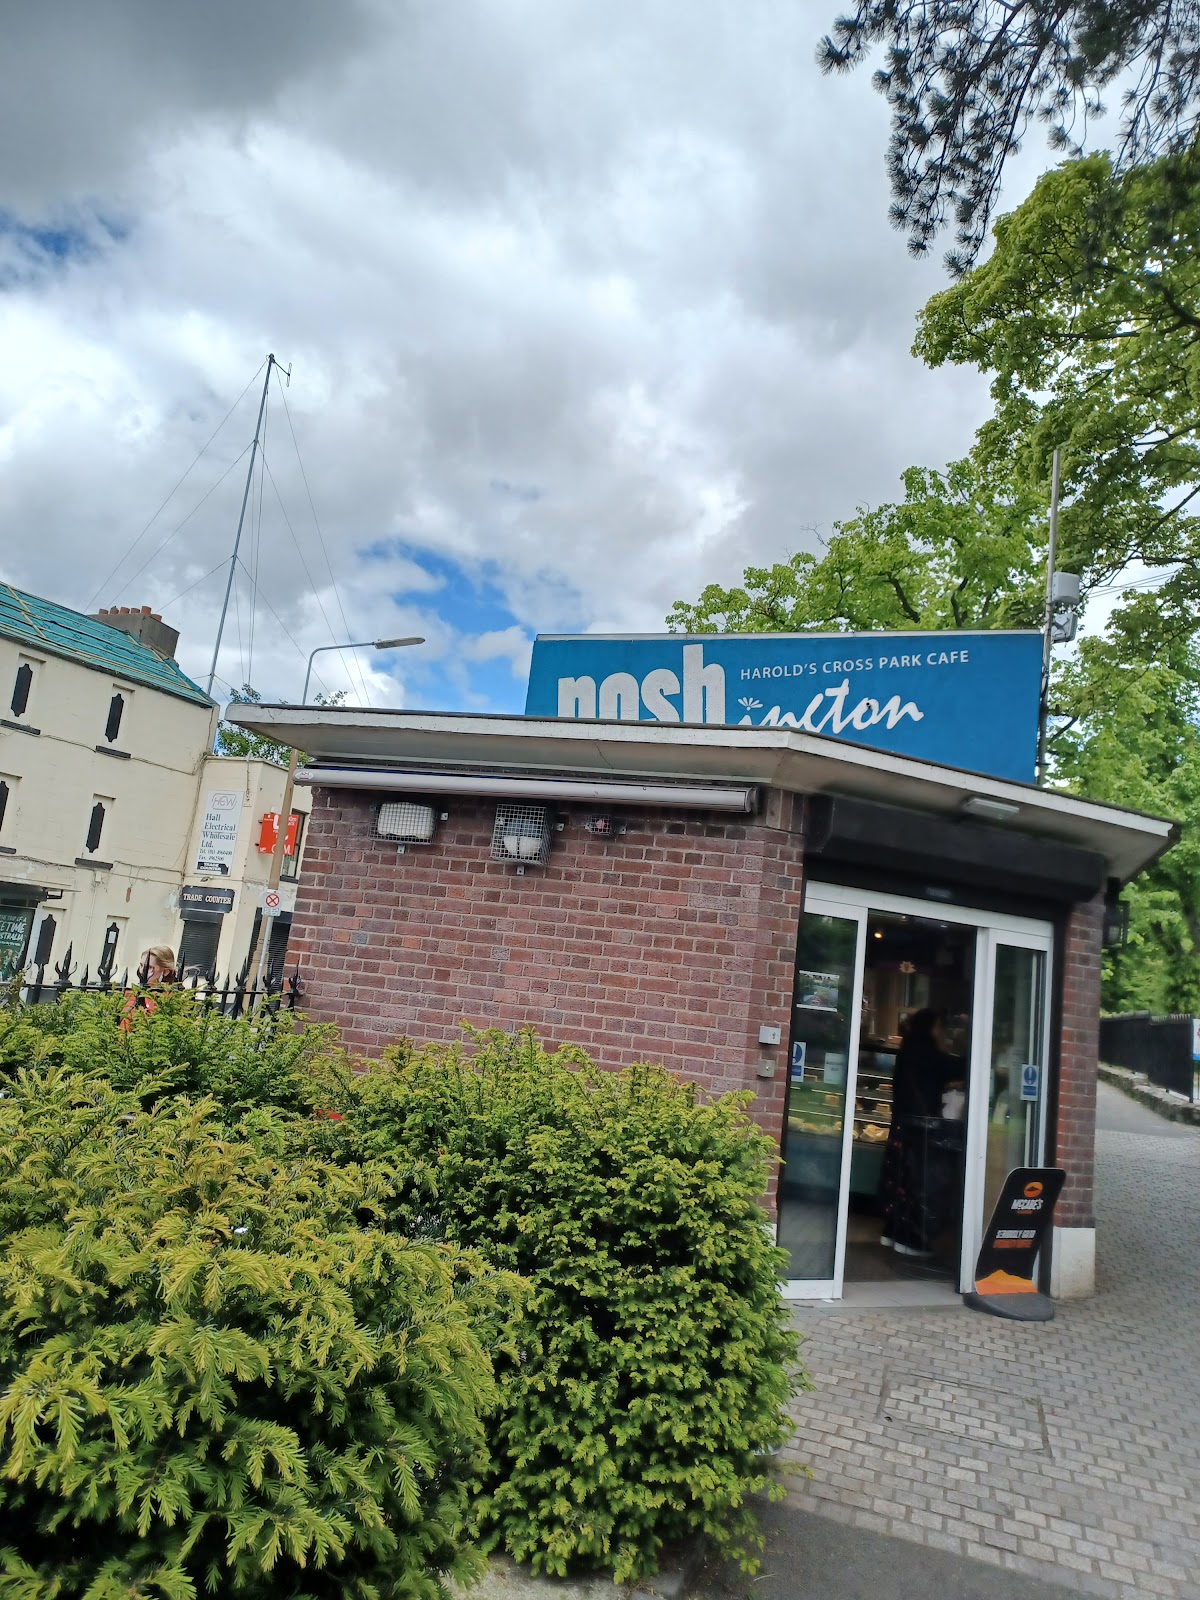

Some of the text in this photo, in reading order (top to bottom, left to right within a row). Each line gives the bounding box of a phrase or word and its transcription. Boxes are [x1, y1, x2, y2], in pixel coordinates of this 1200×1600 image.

[740, 649, 969, 681] HAROLD'S CROSS PARK CAFE
[558, 643, 726, 725] nosh
[206, 813, 221, 821] Hall
[204, 822, 236, 832] Electrical
[202, 831, 236, 841] Wholesale
[201, 840, 214, 848] Ltd.
[183, 893, 232, 905] TRADE COUNTER
